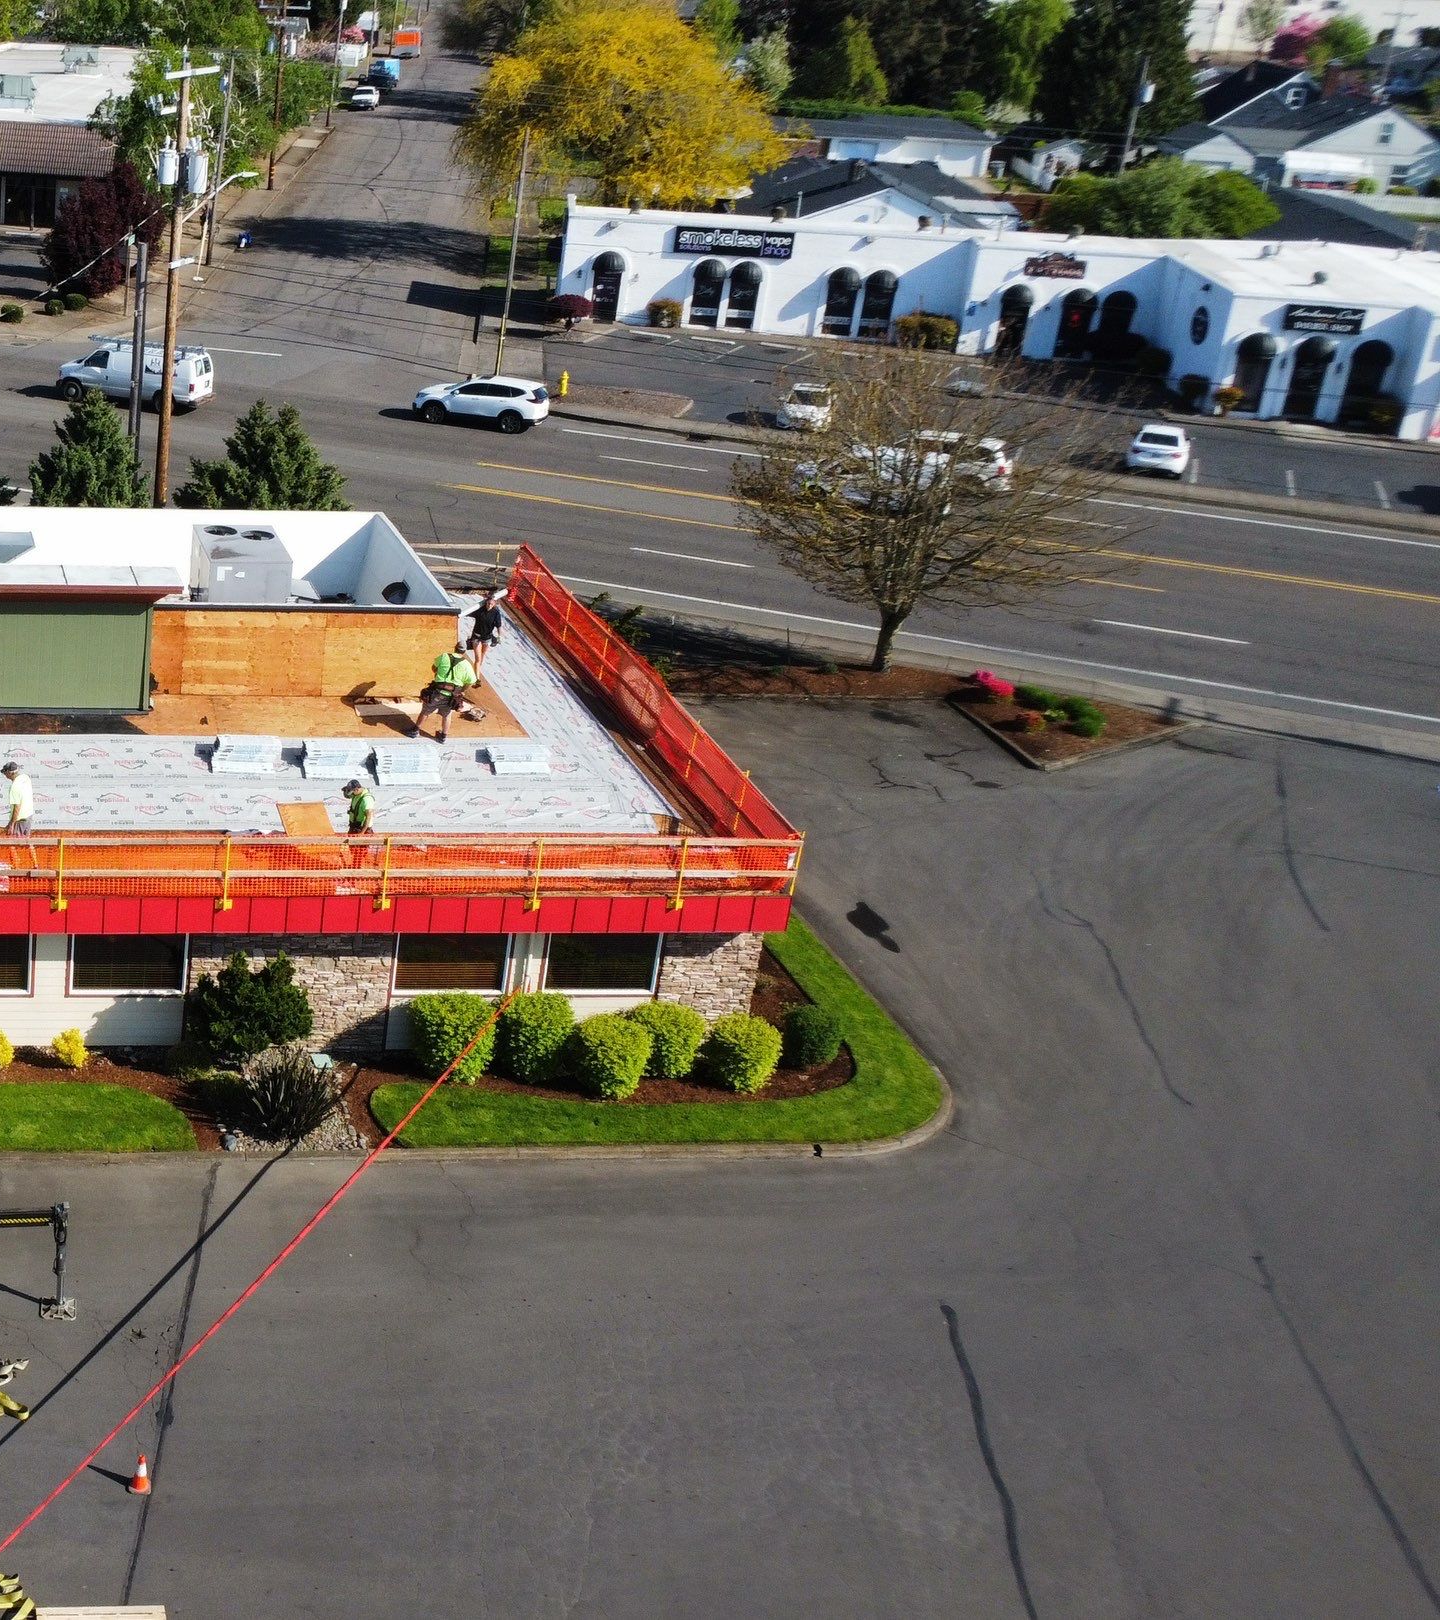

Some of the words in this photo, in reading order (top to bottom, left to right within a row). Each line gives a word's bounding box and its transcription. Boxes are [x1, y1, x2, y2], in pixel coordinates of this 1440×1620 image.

[678, 230, 762, 248] smokeless
[765, 236, 792, 247] vape
[764, 246, 790, 257] shop
